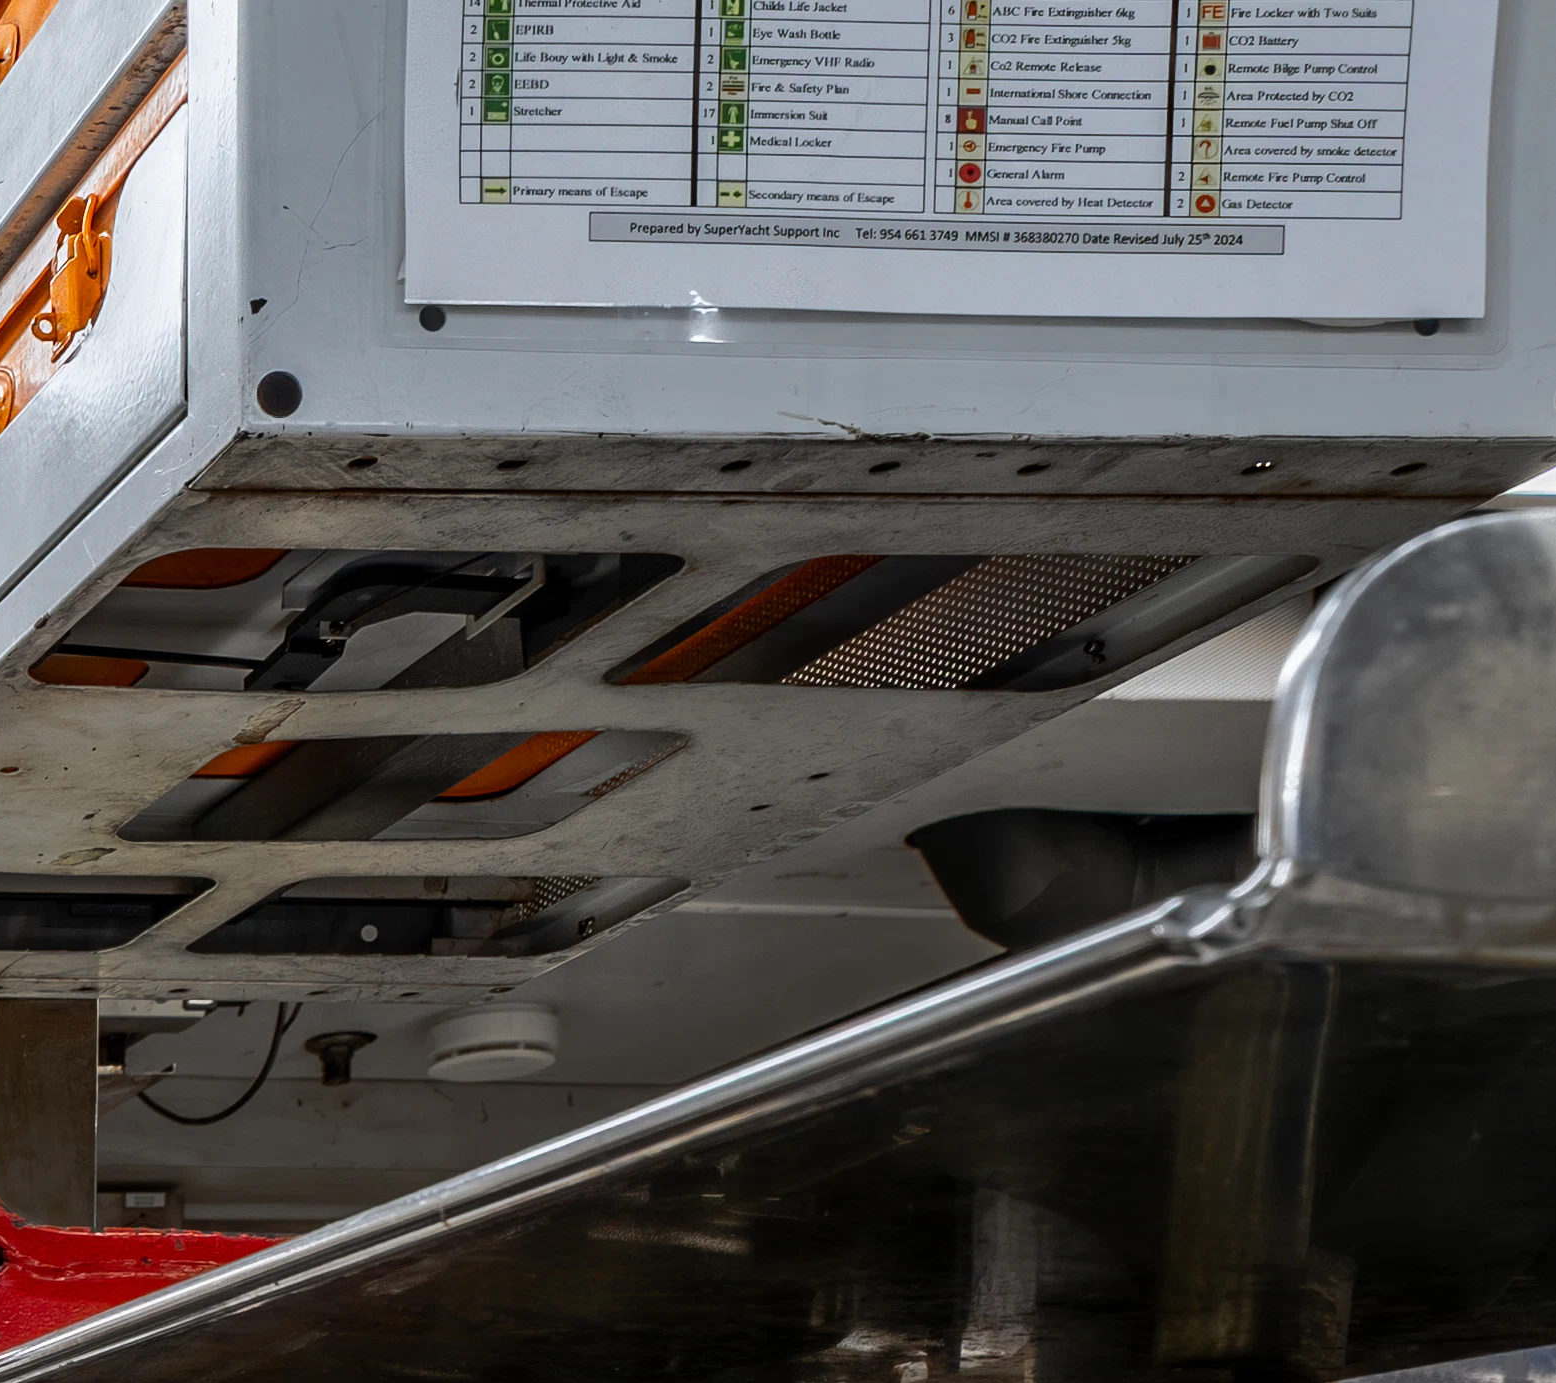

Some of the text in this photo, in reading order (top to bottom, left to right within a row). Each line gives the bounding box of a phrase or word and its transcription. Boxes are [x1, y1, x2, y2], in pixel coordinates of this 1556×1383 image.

[753, 1, 847, 12] Childs Life Jacket
[993, 7, 1135, 20] ABC Fire Extinguisher 6kg
[1231, 9, 1377, 18] Fire Locker with Two Suits
[515, 25, 554, 35] EPIRB
[753, 29, 840, 40] Eye Wash Bottle
[515, 53, 678, 65] Life Bouy with Light & Smoke
[752, 57, 875, 68] Emergency VHF Radio
[514, 80, 549, 89] EEBD
[752, 83, 849, 95] Fire & Safety Plan
[990, 89, 1151, 100] International Shore Connection
[513, 107, 562, 117] Stretcher
[750, 110, 827, 120] Immersion Suit
[989, 116, 1082, 126] Manual Call Point
[1226, 119, 1378, 130] Remote Fuel Pump Shut Off
[750, 136, 832, 148] Medical Locker
[987, 169, 1064, 180] General Alarm
[513, 187, 648, 198] Primary means of Escape
[987, 196, 1153, 208] Area covered by Heat Detector
[1222, 200, 1293, 209] Gas Detector
[630, 222, 683, 236] Prepared
[687, 224, 701, 236] by
[704, 224, 770, 238] SuperYacht
[773, 226, 819, 239] Support
[823, 228, 840, 238] Inc
[856, 228, 877, 240] Tel:
[880, 229, 901, 240] 954
[905, 229, 925, 240] 661
[930, 230, 958, 242] 3749
[965, 231, 999, 242] MMSI
[1003, 232, 1010, 242] #
[1013, 232, 1079, 244] 368380270
[1083, 233, 1110, 244] Date
[1114, 234, 1158, 245] Revised
[1161, 234, 1185, 248] July
[1214, 235, 1243, 246] 2024
